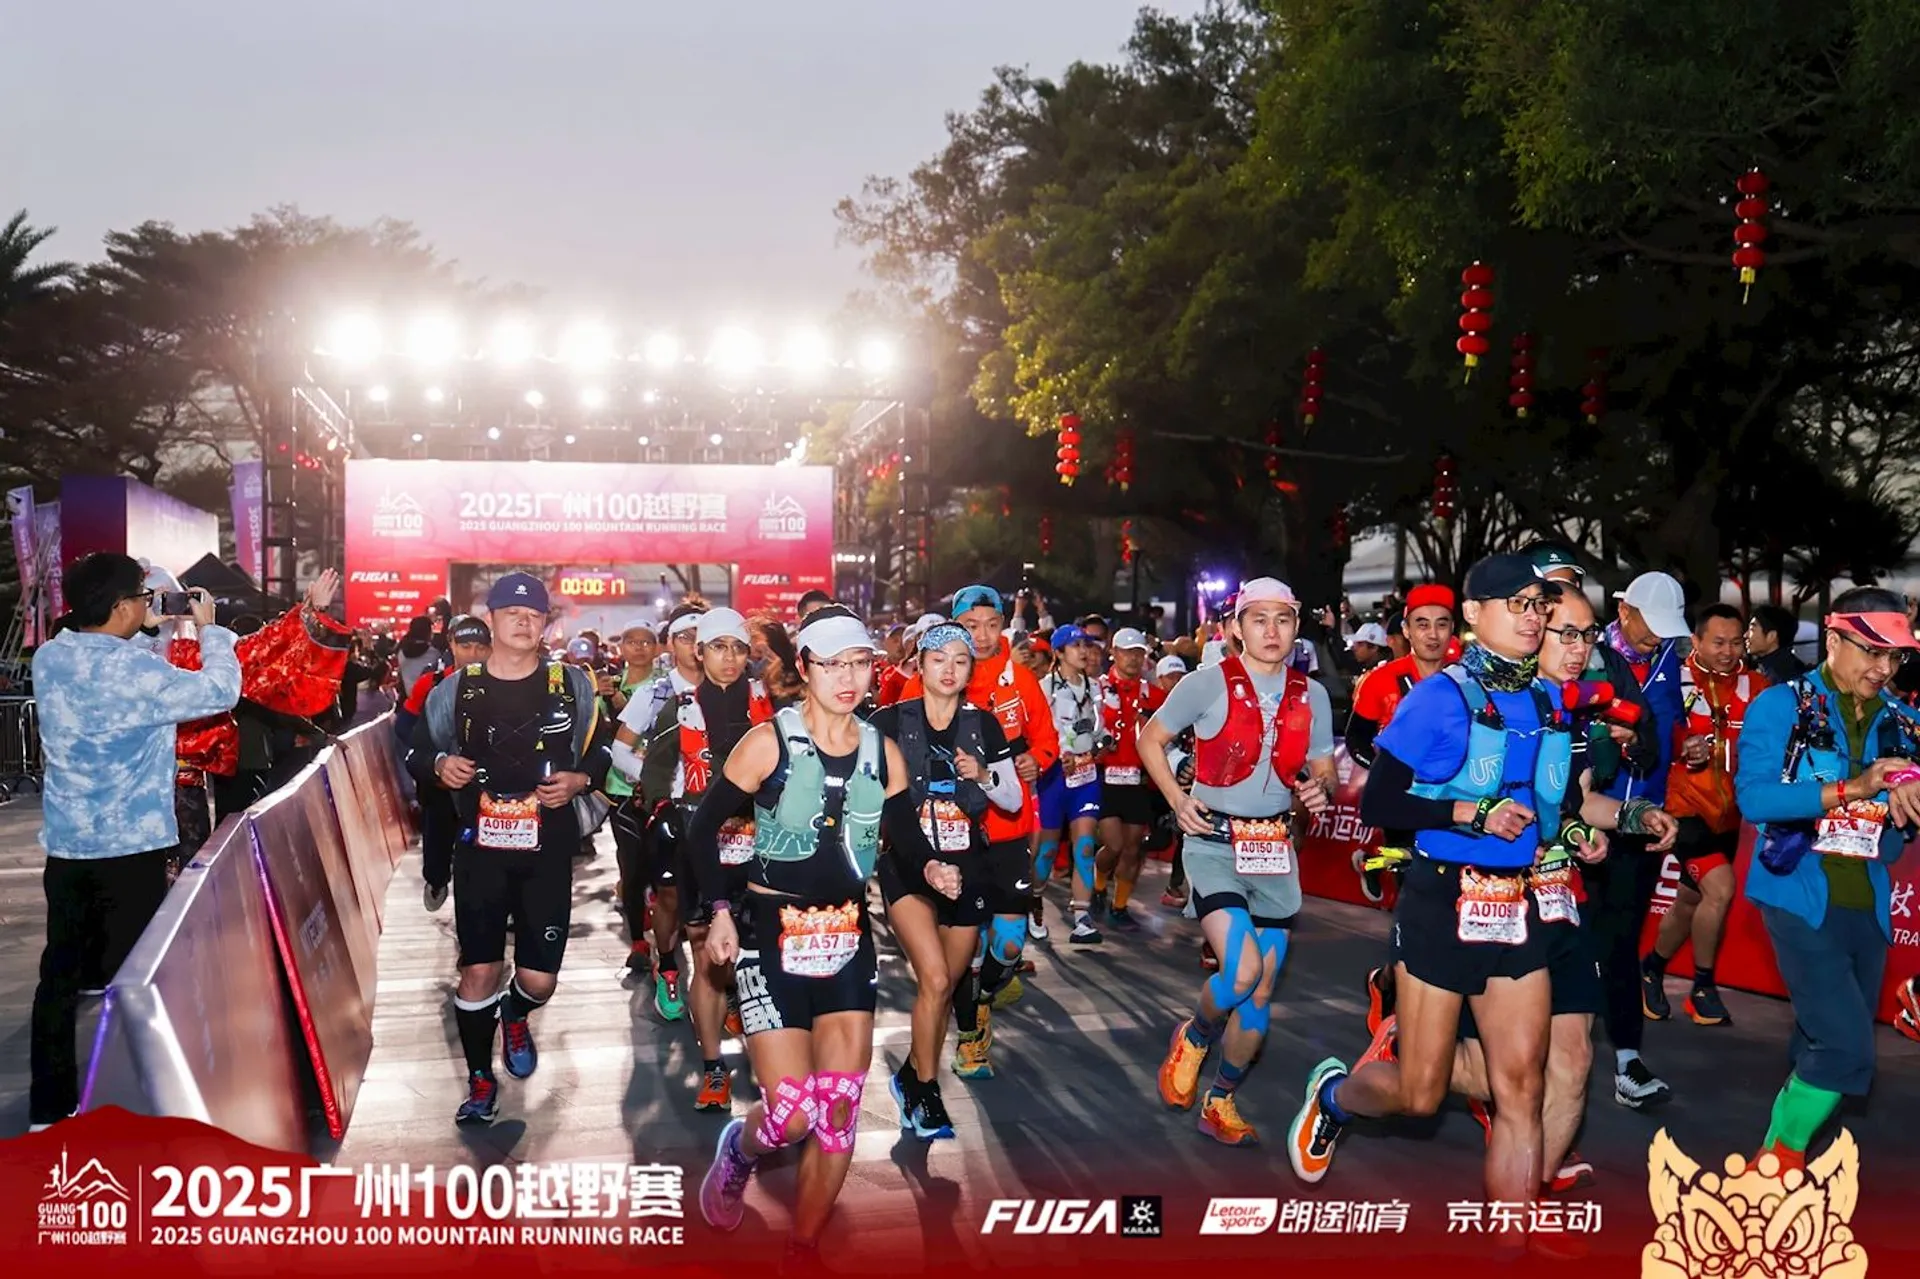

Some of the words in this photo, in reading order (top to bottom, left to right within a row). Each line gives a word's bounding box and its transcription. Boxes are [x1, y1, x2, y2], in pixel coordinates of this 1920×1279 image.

[459, 491, 727, 520] 2025广州100越野赛
[459, 521, 487, 532] 2025
[489, 521, 560, 532] GUANGZHOU
[584, 521, 644, 533] MOUNTAIN
[647, 522, 697, 533] RUNNING
[700, 522, 727, 533] RACE
[350, 571, 389, 583] FUGA
[743, 574, 779, 585] FUGA
[484, 819, 519, 830] A0187
[1306, 805, 1374, 844] 东运动
[1241, 842, 1272, 854] A0150
[809, 934, 839, 950] A57
[1893, 928, 1920, 947] TRA
